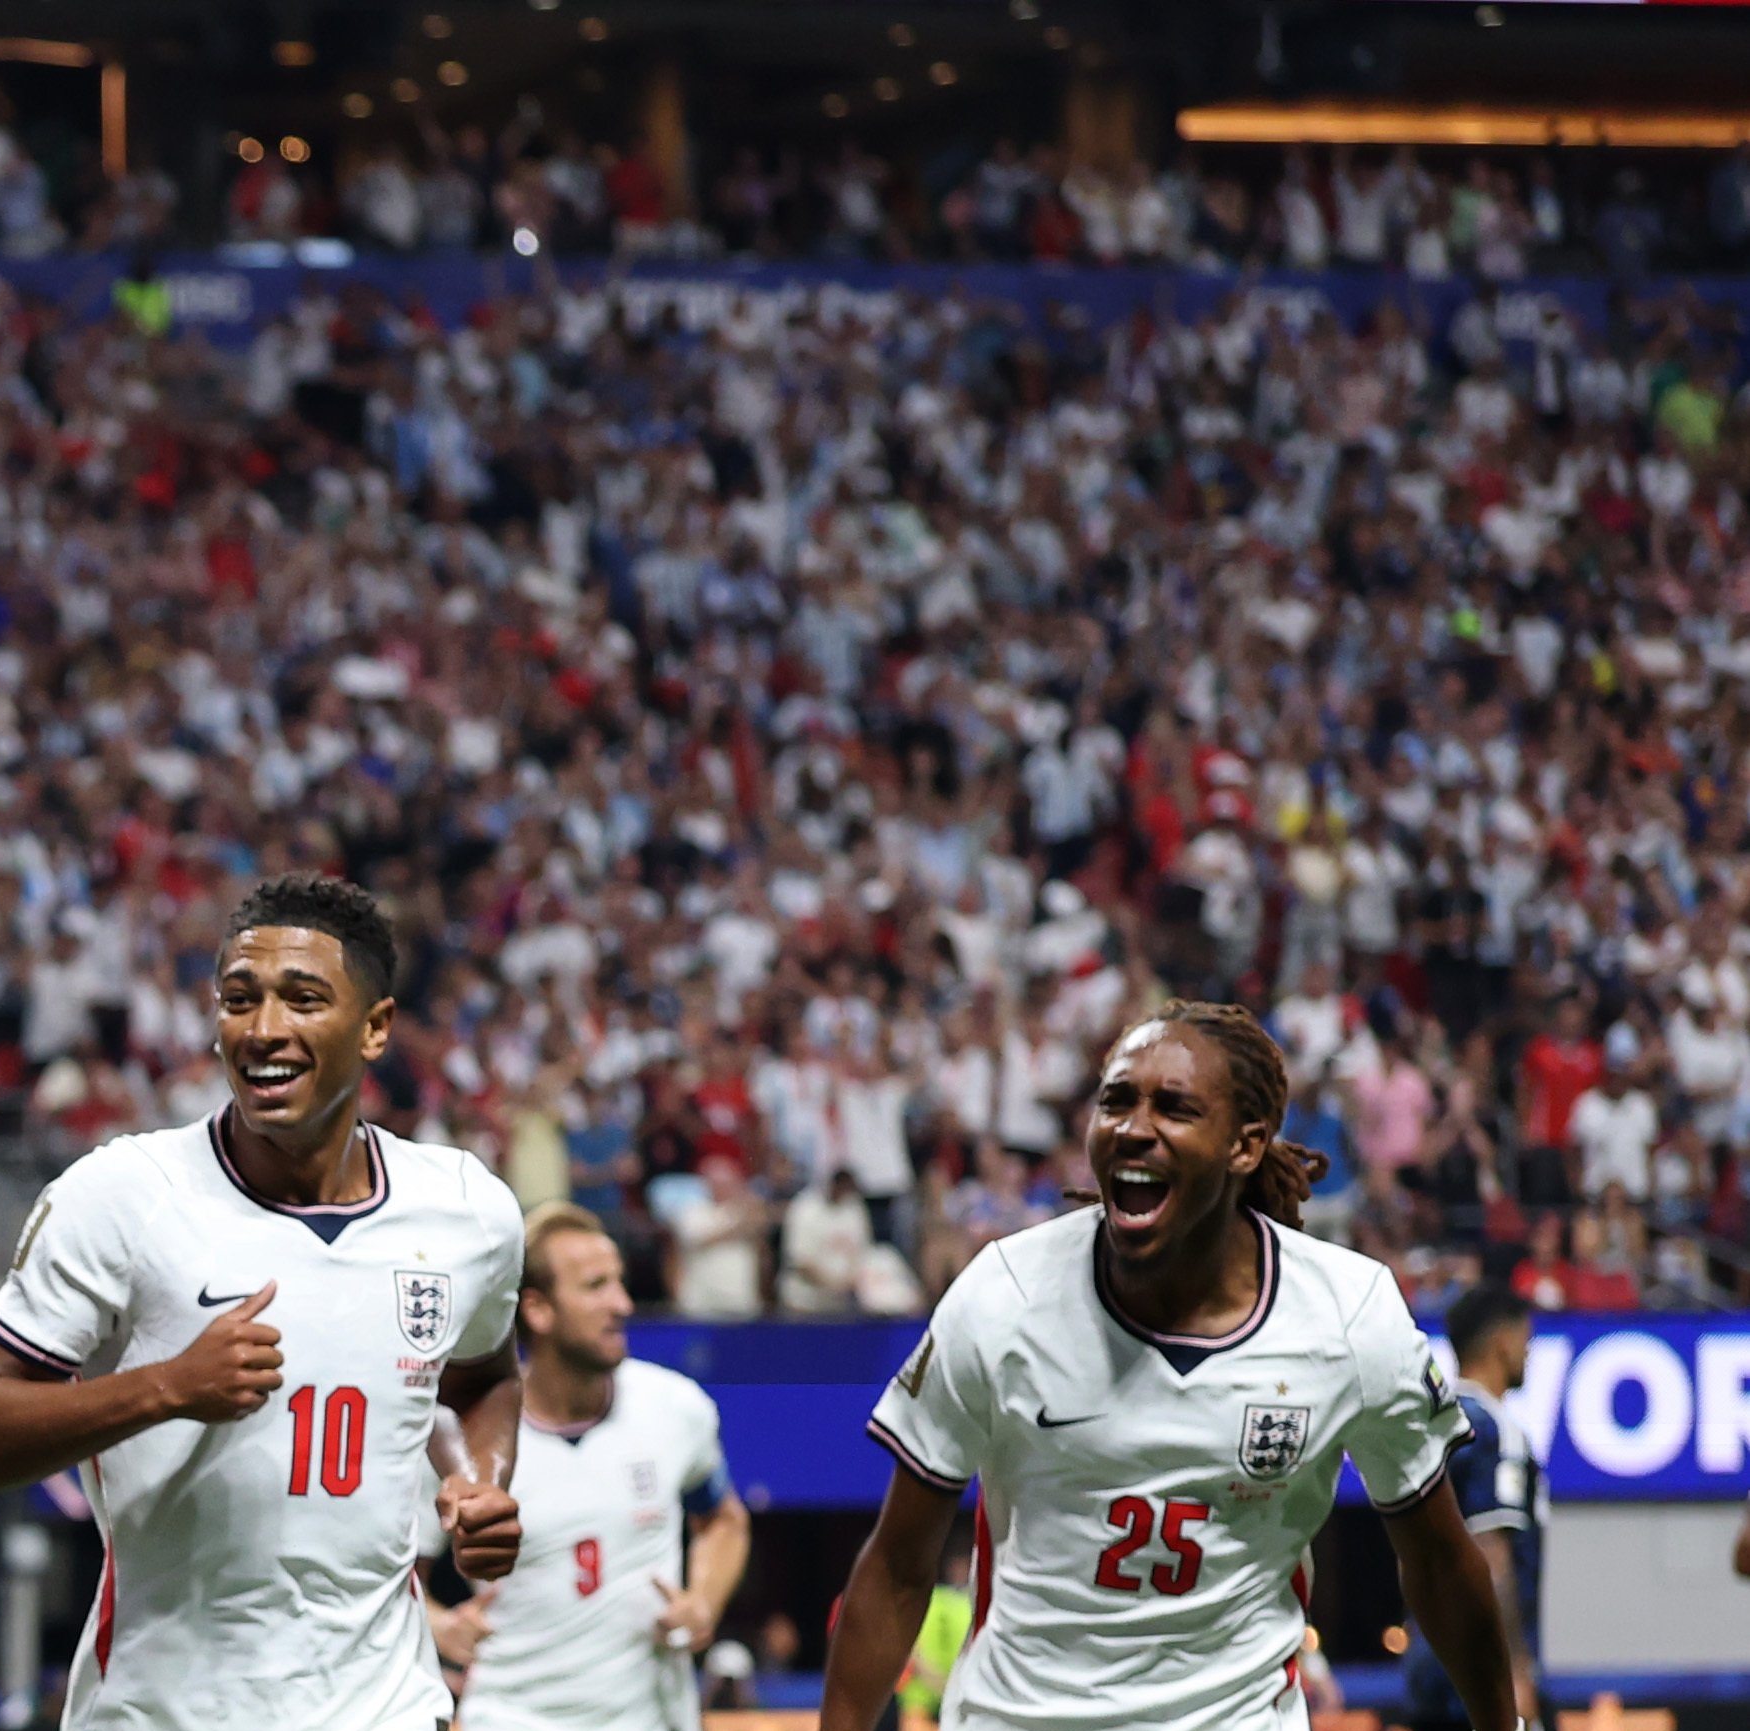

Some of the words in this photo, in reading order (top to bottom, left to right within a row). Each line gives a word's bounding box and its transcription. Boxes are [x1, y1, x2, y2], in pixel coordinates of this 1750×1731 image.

[288, 1384, 367, 1497] 10
[574, 1537, 601, 1597] 9
[1095, 1495, 1210, 1596] 25
